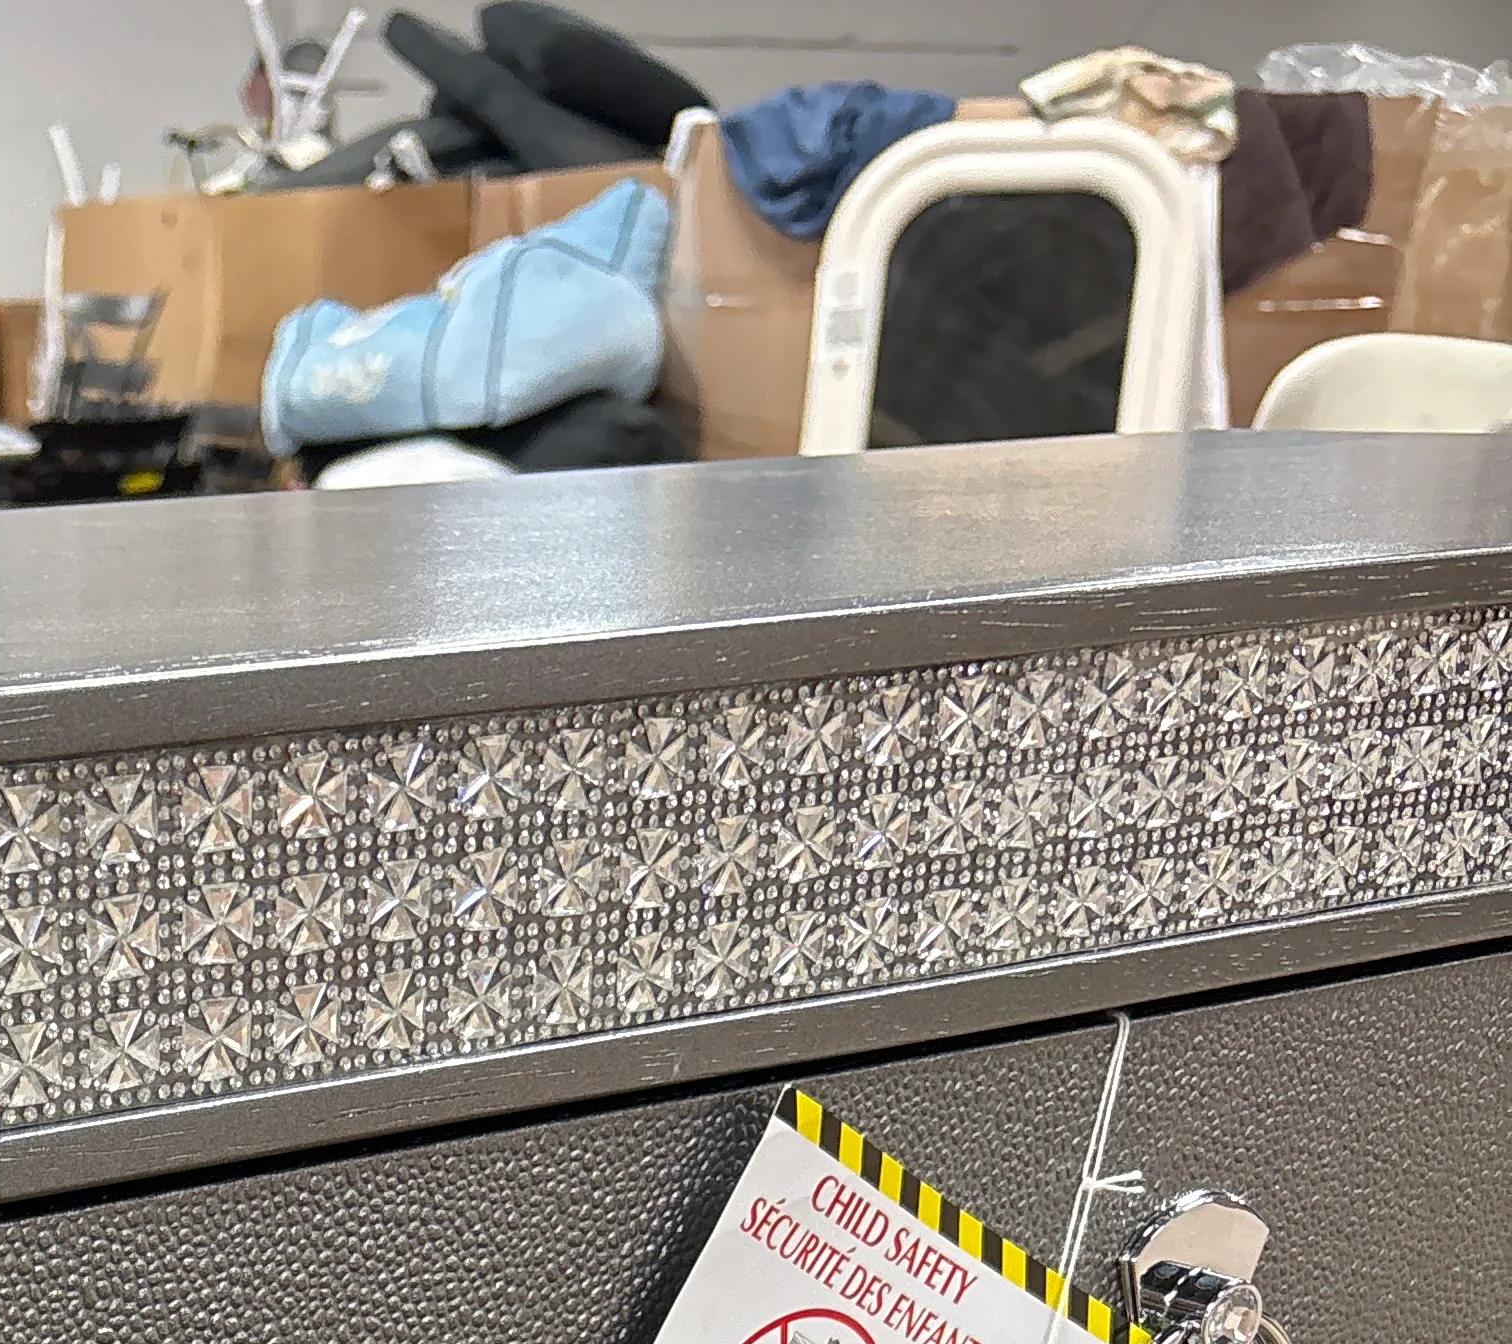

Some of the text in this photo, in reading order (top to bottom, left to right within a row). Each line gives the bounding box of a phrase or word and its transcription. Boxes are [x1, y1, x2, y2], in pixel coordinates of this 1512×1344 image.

[738, 1196, 857, 1289] SÉCURITÉ
[837, 1263, 893, 1317] DES
[810, 1174, 978, 1305] CHILD SAFETY
